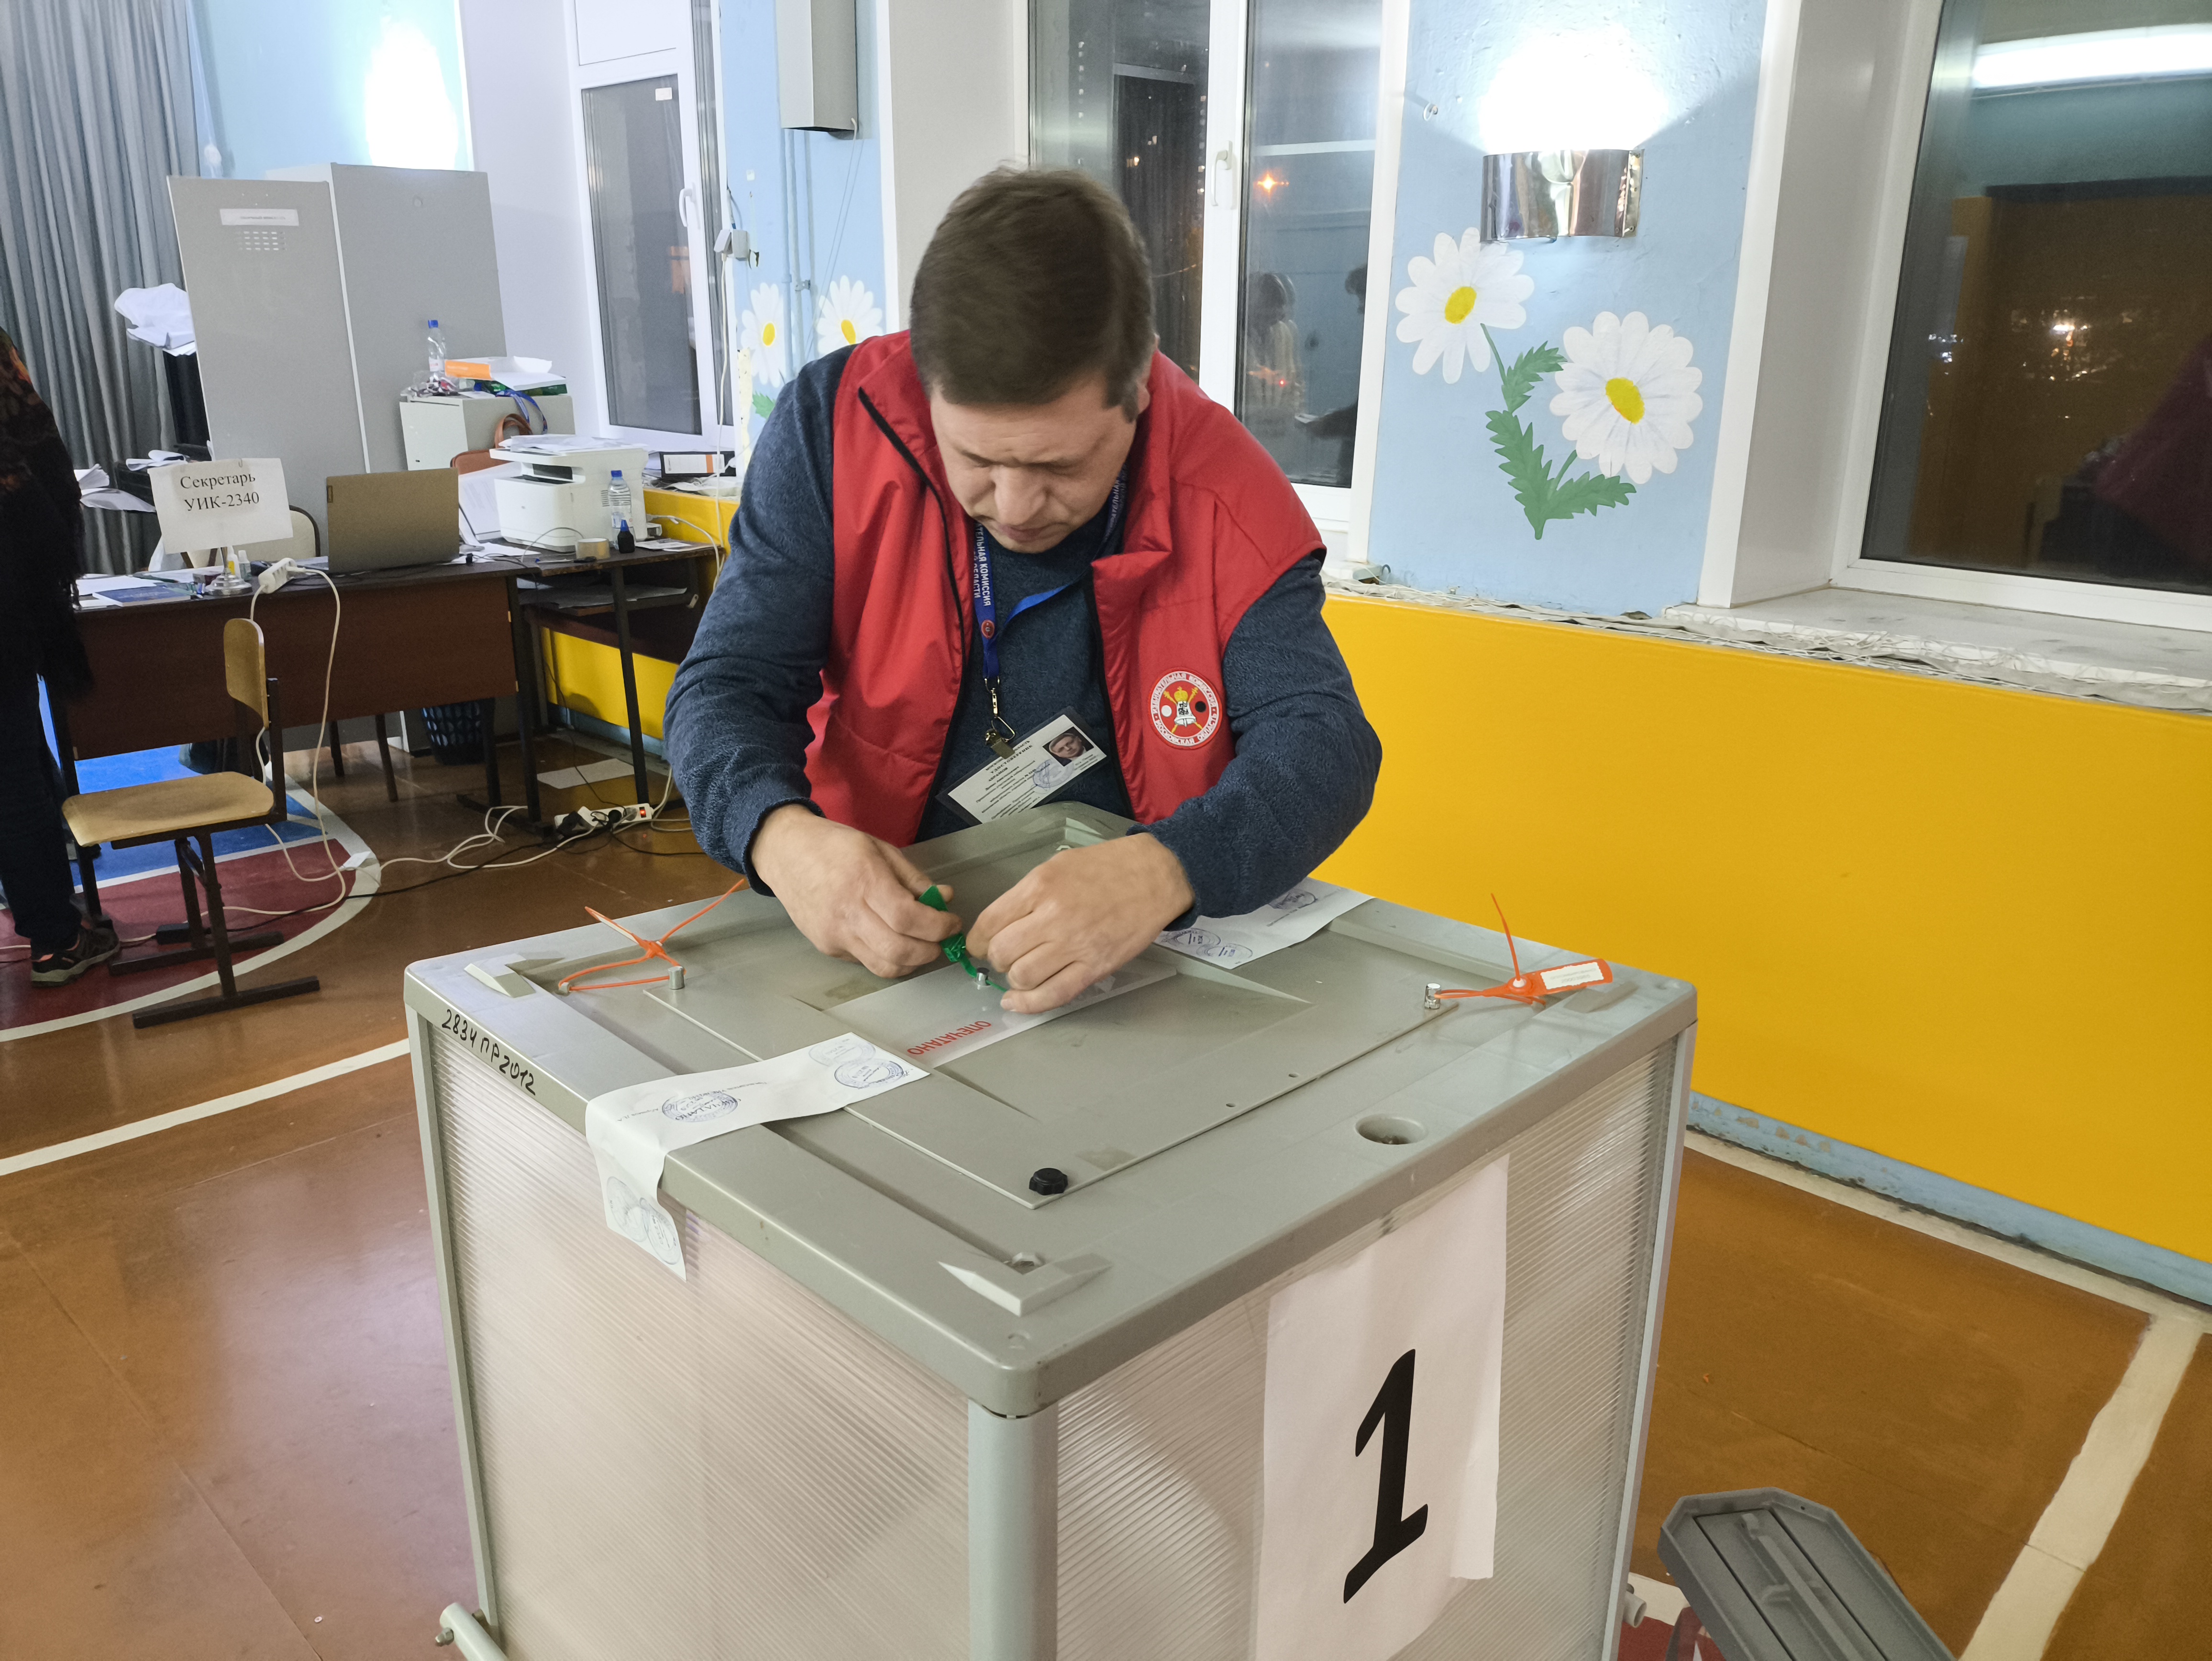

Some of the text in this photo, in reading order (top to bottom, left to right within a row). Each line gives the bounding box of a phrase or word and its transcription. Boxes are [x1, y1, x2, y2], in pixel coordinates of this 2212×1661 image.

[180, 474, 255, 489] Секретарь
[184, 492, 259, 511] УИК-2340
[979, 563, 991, 607] КОМИССИЯ
[907, 1021, 992, 1055] ОПЕЧАТАНО
[1343, 1349, 1428, 1604] 1
